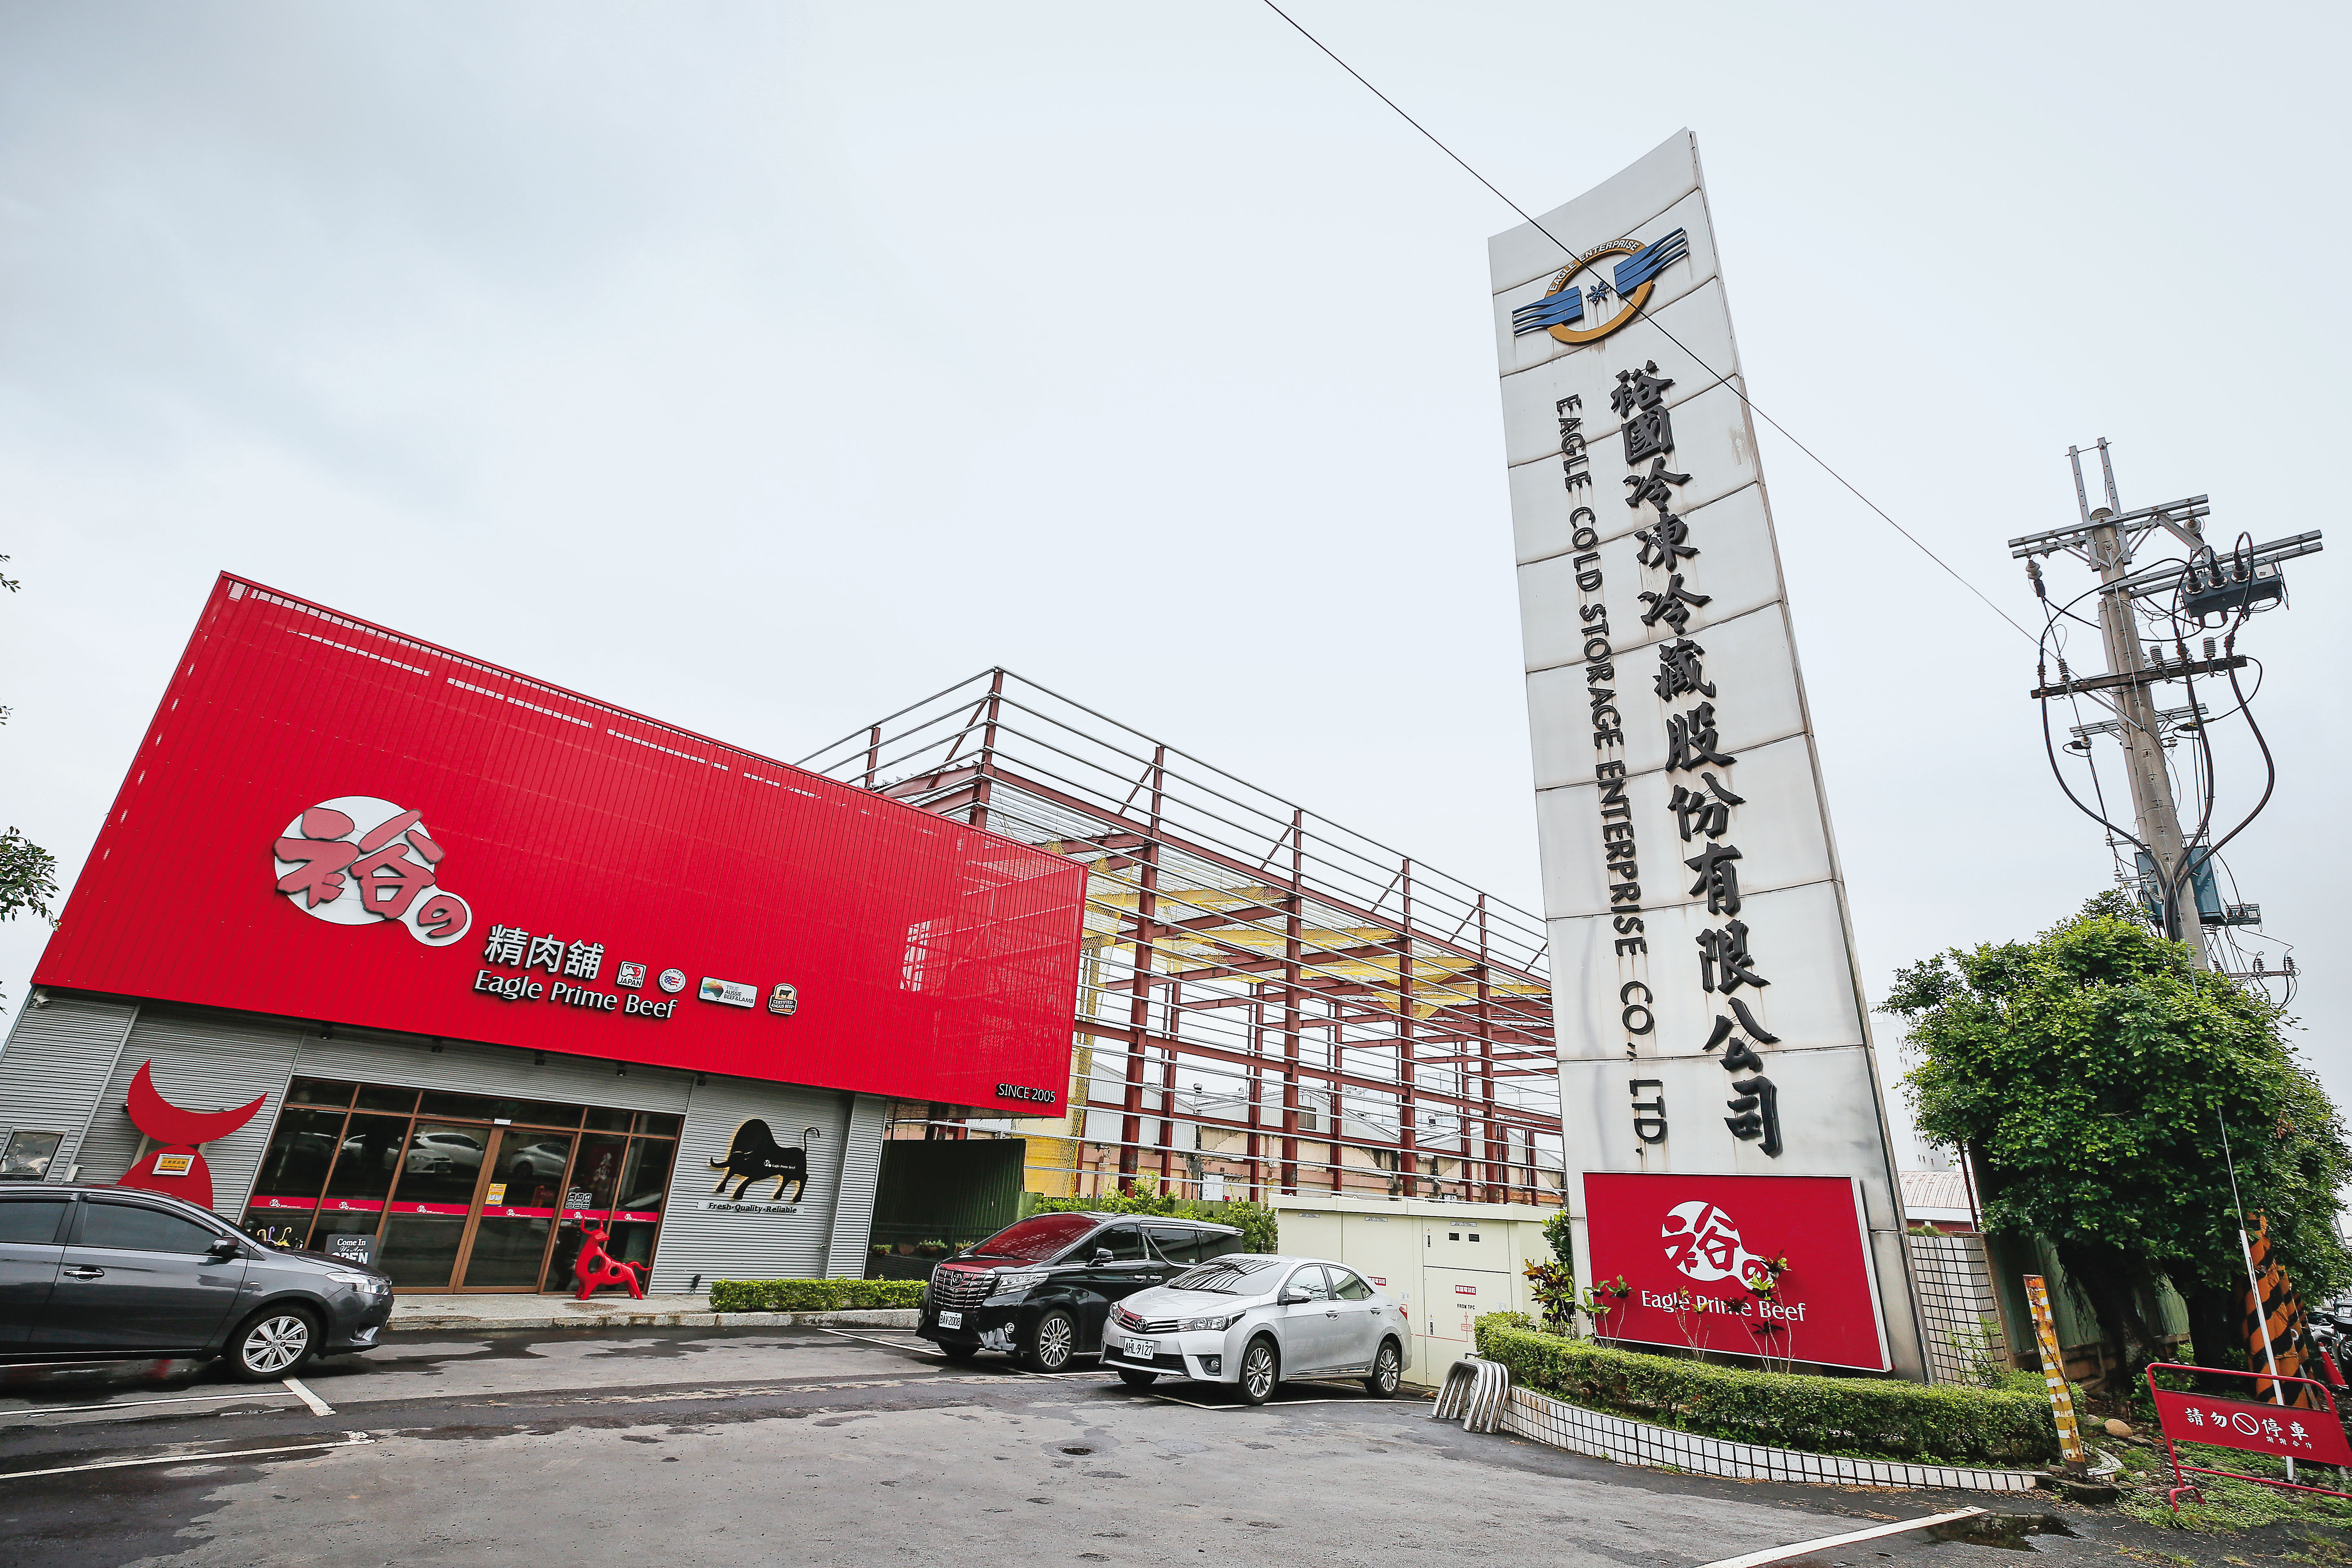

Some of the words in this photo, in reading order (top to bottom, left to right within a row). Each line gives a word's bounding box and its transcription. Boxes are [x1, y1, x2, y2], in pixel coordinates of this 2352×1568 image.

[1549, 261, 1577, 292] EAGLE
[1579, 239, 1640, 262] ENTERPRISE
[1555, 393, 1592, 492] EAGLE
[1569, 506, 1603, 592] COLD
[1579, 602, 1625, 750] STORAGE
[1610, 359, 1784, 1159] 裕國冷凍冷藏股份有限公司
[1595, 761, 1648, 958] ENTERPRISE
[484, 924, 605, 980] 精肉舖
[474, 969, 543, 1000] Eagle
[550, 981, 618, 1010] Prime
[625, 994, 678, 1018] Beef
[618, 977, 642, 987] JAPAN
[998, 1083, 1030, 1099] SINCE
[1031, 1088, 1056, 1102] 2005
[1629, 1079, 1667, 1156] LTD.
[940, 1314, 961, 1327] BAV-2008
[1642, 1290, 1690, 1314] Eagle
[1758, 1300, 1806, 1322] Beef
[1125, 1341, 1154, 1357] AHL-9127
[2266, 1436, 2312, 1449] 謝謝合作
